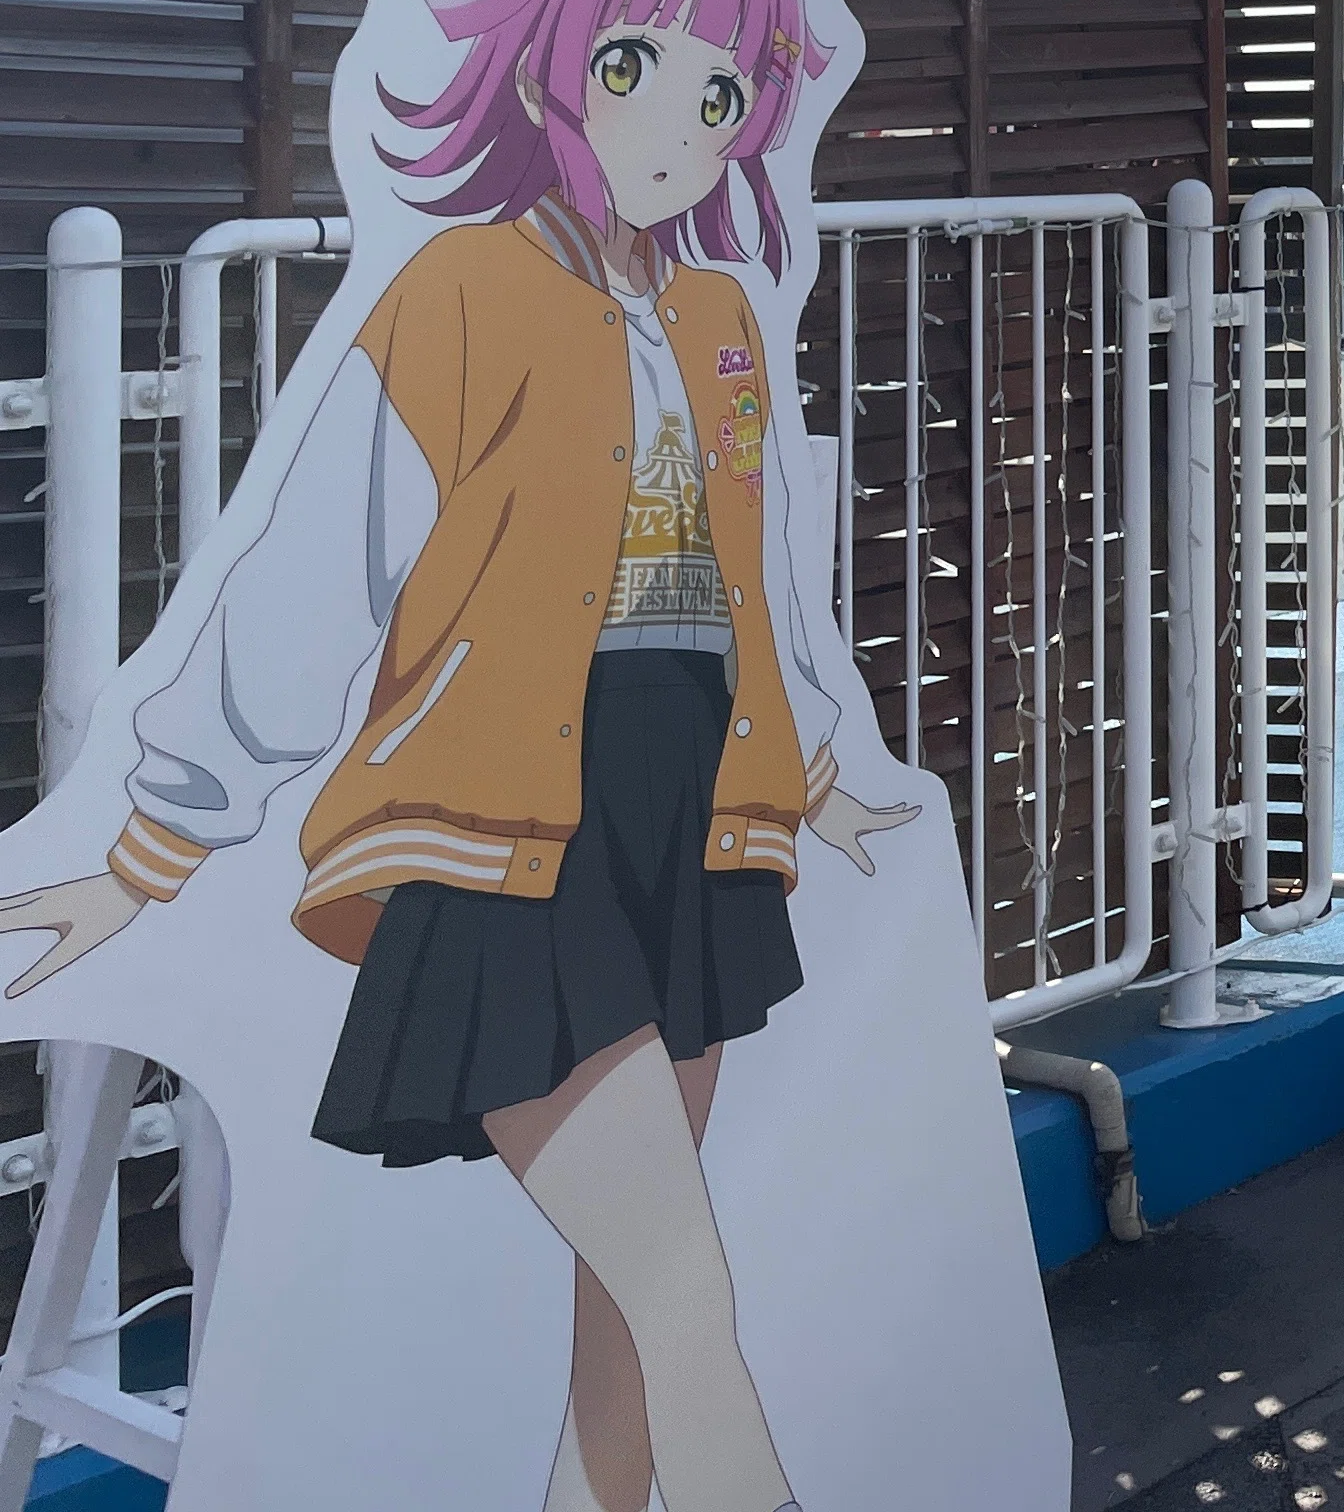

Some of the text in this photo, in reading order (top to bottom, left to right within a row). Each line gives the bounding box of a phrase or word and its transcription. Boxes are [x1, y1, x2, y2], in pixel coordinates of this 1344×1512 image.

[632, 567, 712, 589] FAN FUN
[630, 589, 712, 612] FESTIVAL
